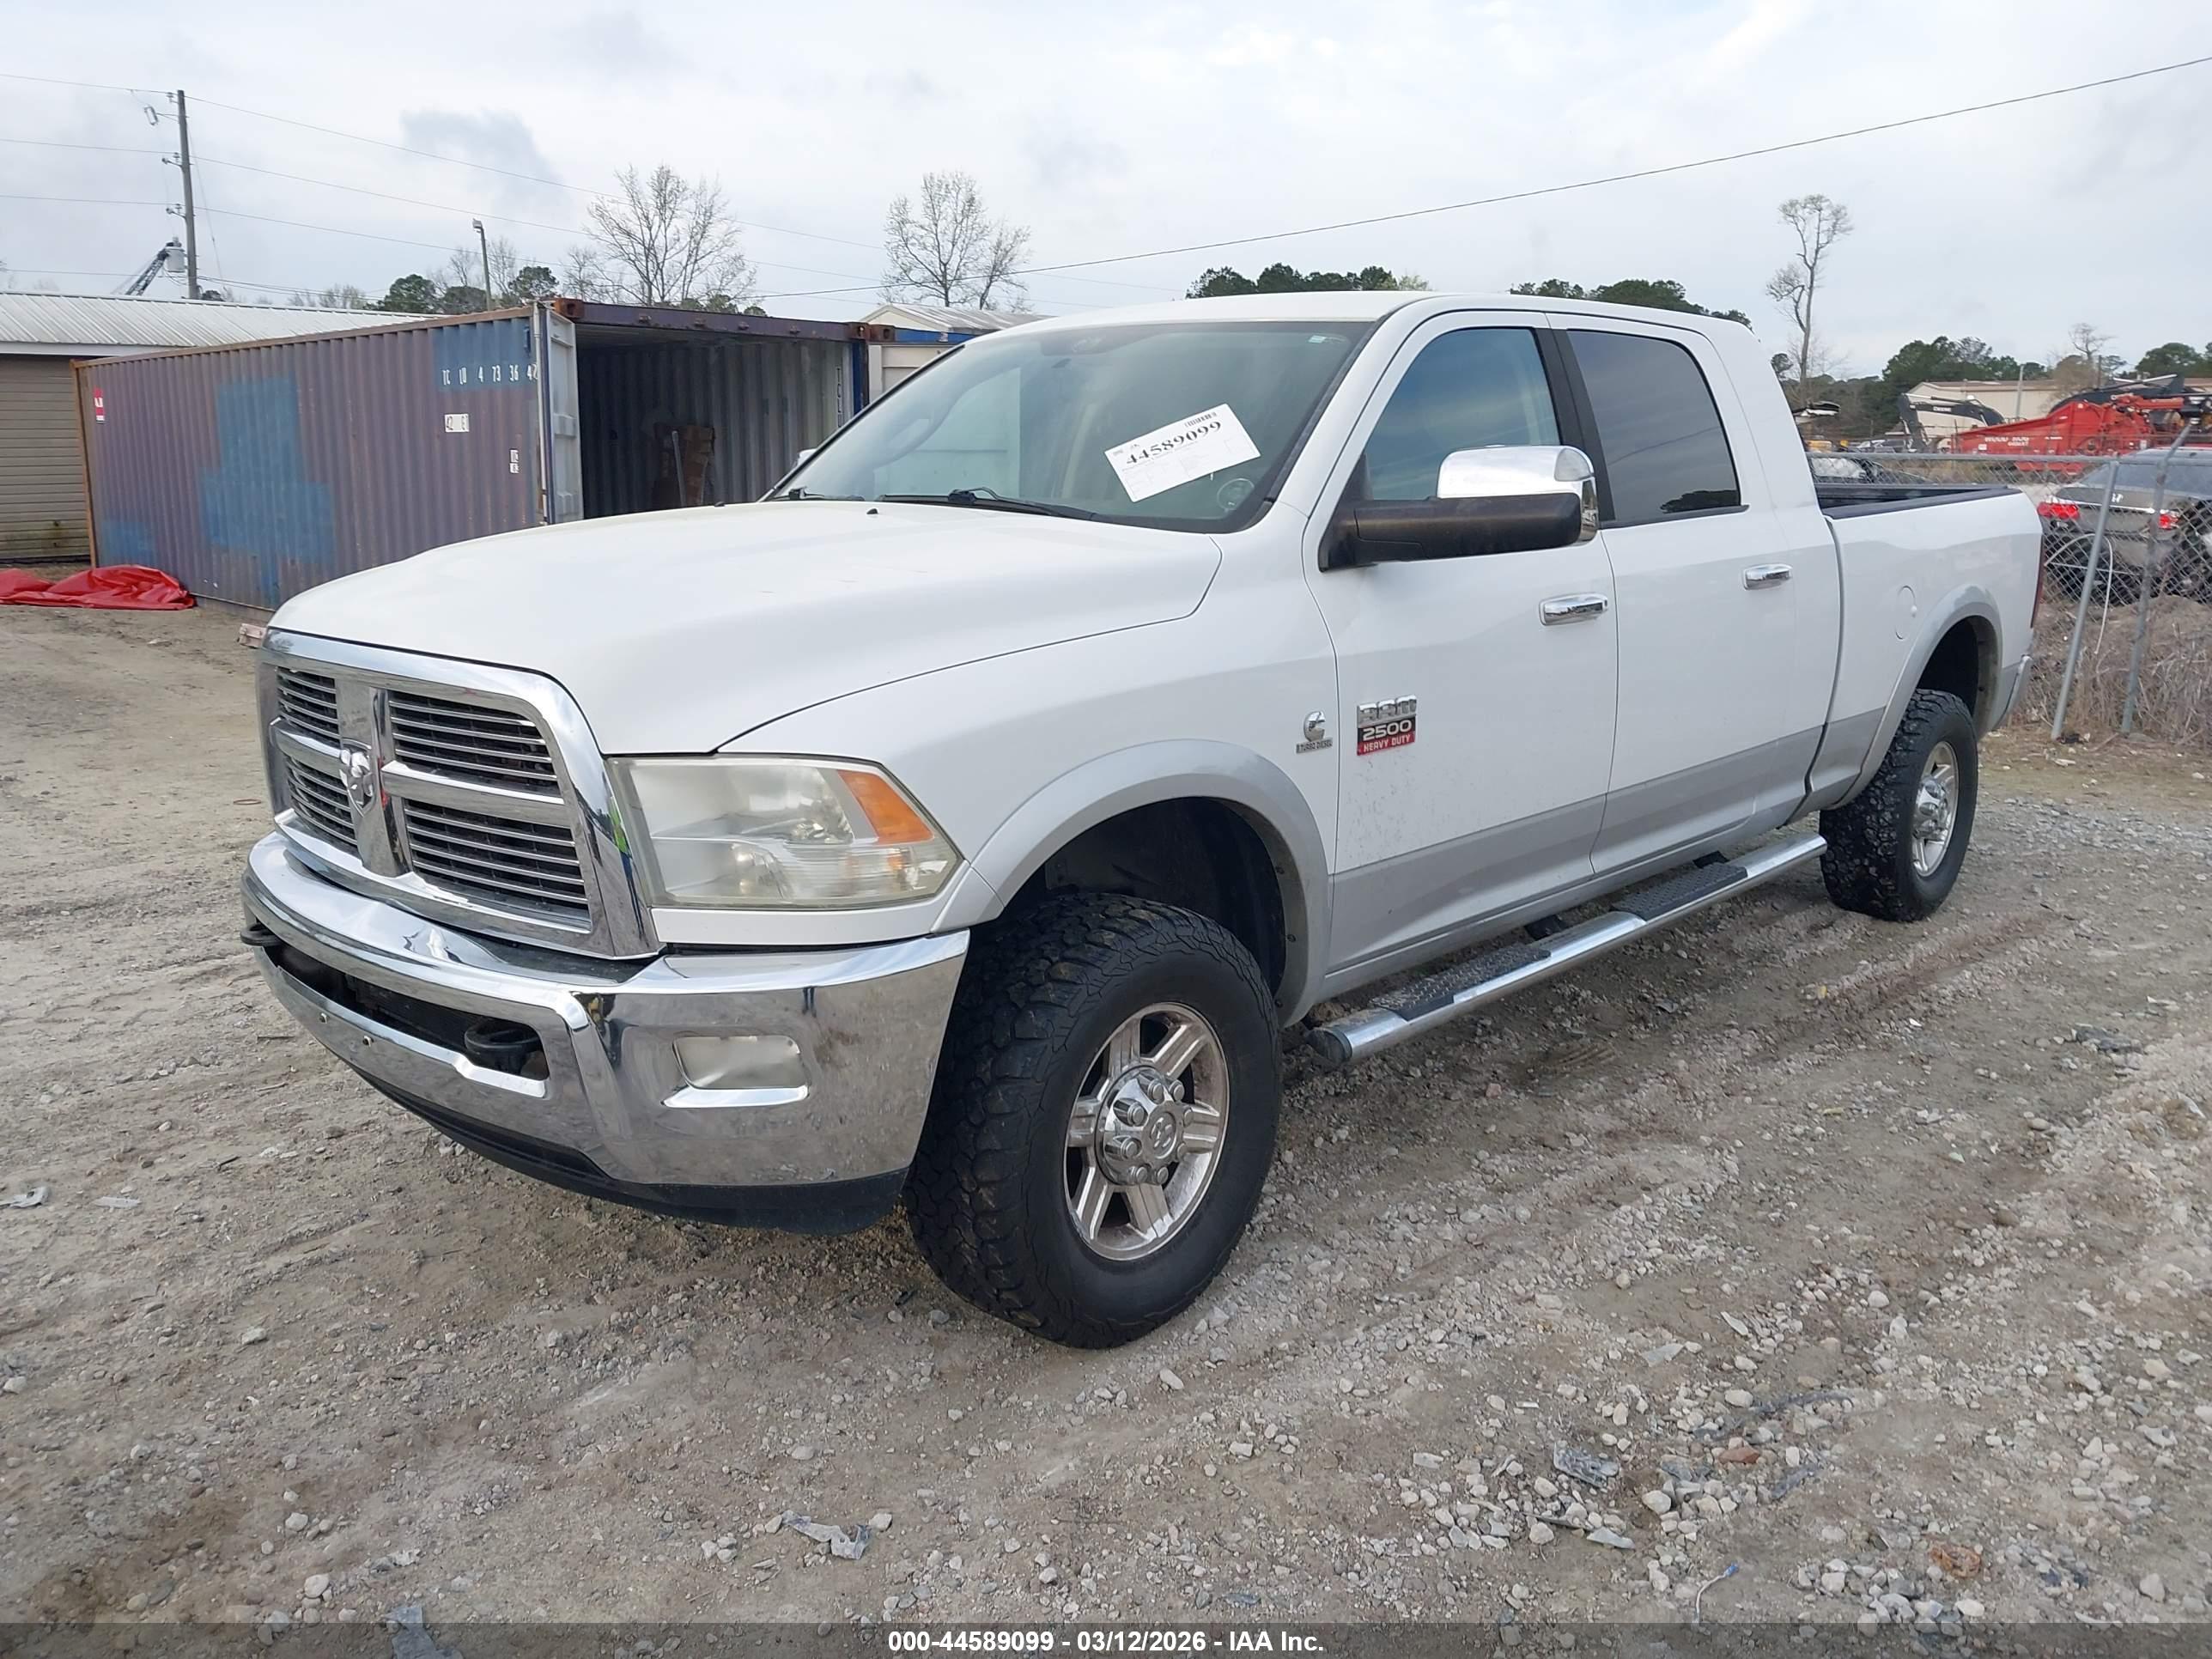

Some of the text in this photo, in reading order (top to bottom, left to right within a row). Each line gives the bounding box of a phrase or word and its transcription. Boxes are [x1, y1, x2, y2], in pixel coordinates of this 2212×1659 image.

[1126, 421, 1221, 465] 44589099
[1358, 695, 1417, 724] RAM
[1362, 720, 1413, 742] 2500
[1363, 733, 1411, 753] HEAVY DUTY
